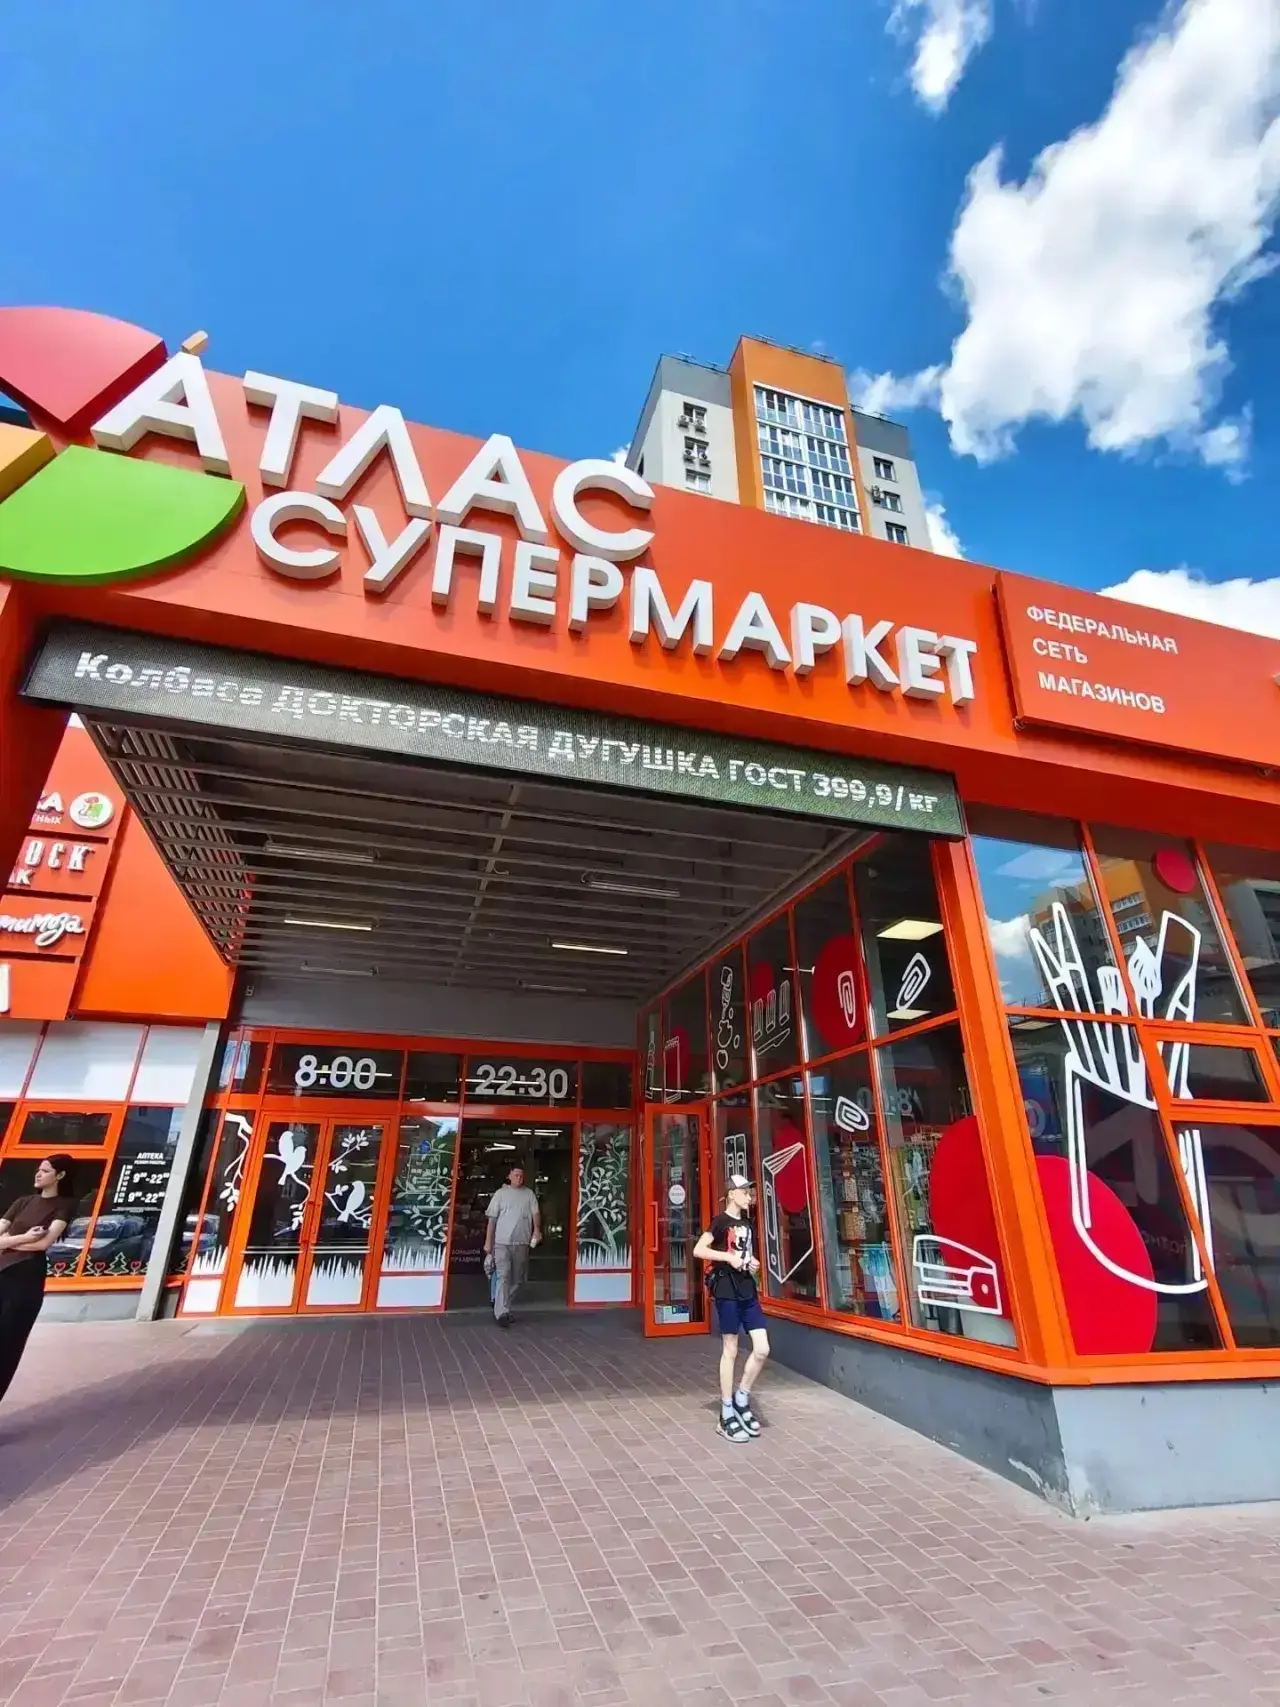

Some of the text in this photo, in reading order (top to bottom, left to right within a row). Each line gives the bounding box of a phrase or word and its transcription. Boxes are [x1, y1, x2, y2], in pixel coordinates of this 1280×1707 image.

[90, 351, 656, 562] АТЛАС
[250, 490, 977, 706] СУПЕРМАРКЕТ
[1027, 605, 1178, 654] ФЕДЕРАЛЬНАЯ
[1033, 638, 1088, 664] СЕТЬ
[1038, 671, 1166, 714] МАГАЗИНОВ
[74, 651, 263, 706] Колбаса
[271, 685, 538, 751] ДОКТОРСКАЯ
[549, 730, 720, 779] ДУГУШКА
[729, 759, 806, 792] ГОСТ
[295, 1054, 377, 1090] 8:00
[475, 1064, 568, 1099] 22:30
